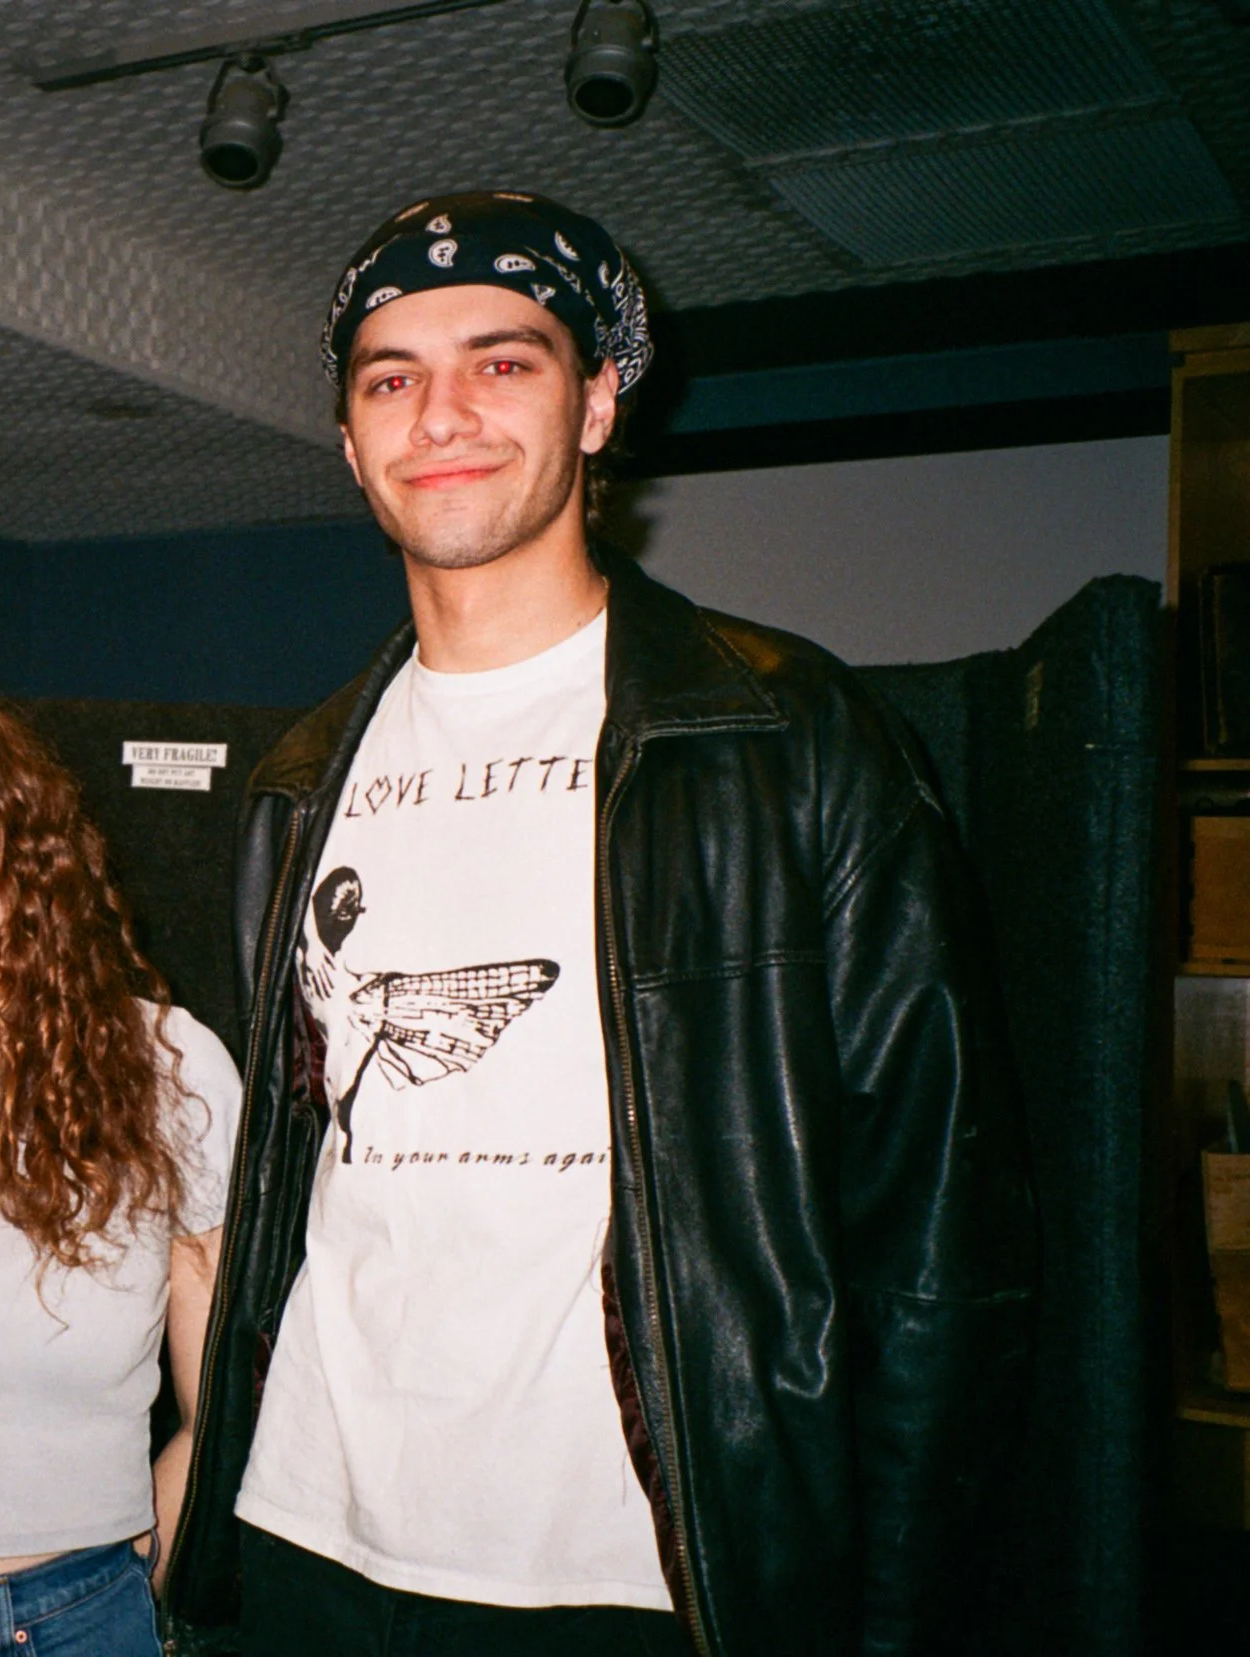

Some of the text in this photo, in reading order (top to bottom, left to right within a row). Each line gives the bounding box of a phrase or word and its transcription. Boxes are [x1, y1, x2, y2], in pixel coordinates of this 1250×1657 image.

[132, 747, 159, 760] VERY
[363, 1146, 383, 1164] In
[391, 1151, 449, 1171] your
[458, 1151, 534, 1165] arms
